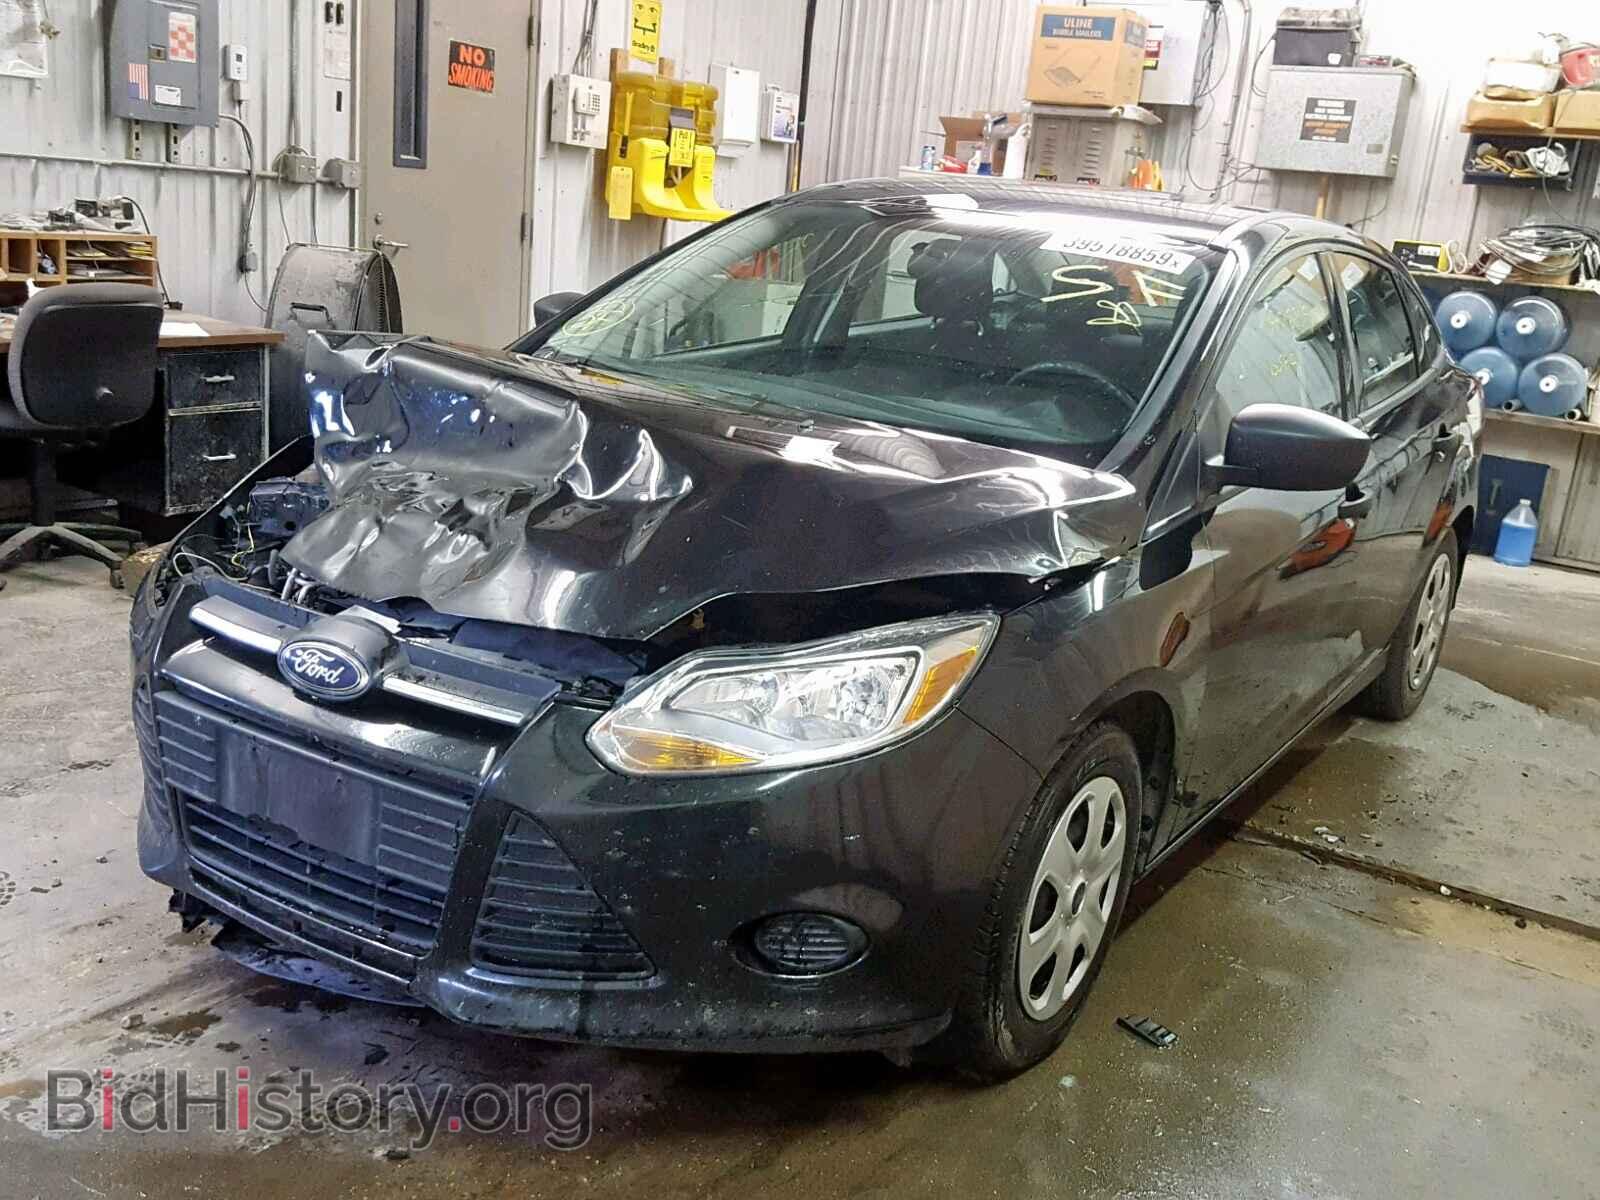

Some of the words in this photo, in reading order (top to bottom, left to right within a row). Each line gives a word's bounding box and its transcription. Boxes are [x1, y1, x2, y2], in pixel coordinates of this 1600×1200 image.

[1064, 16, 1093, 29] ULINE
[459, 44, 486, 67] NO
[448, 62, 494, 91] SMOKING
[291, 648, 345, 684] Ford
